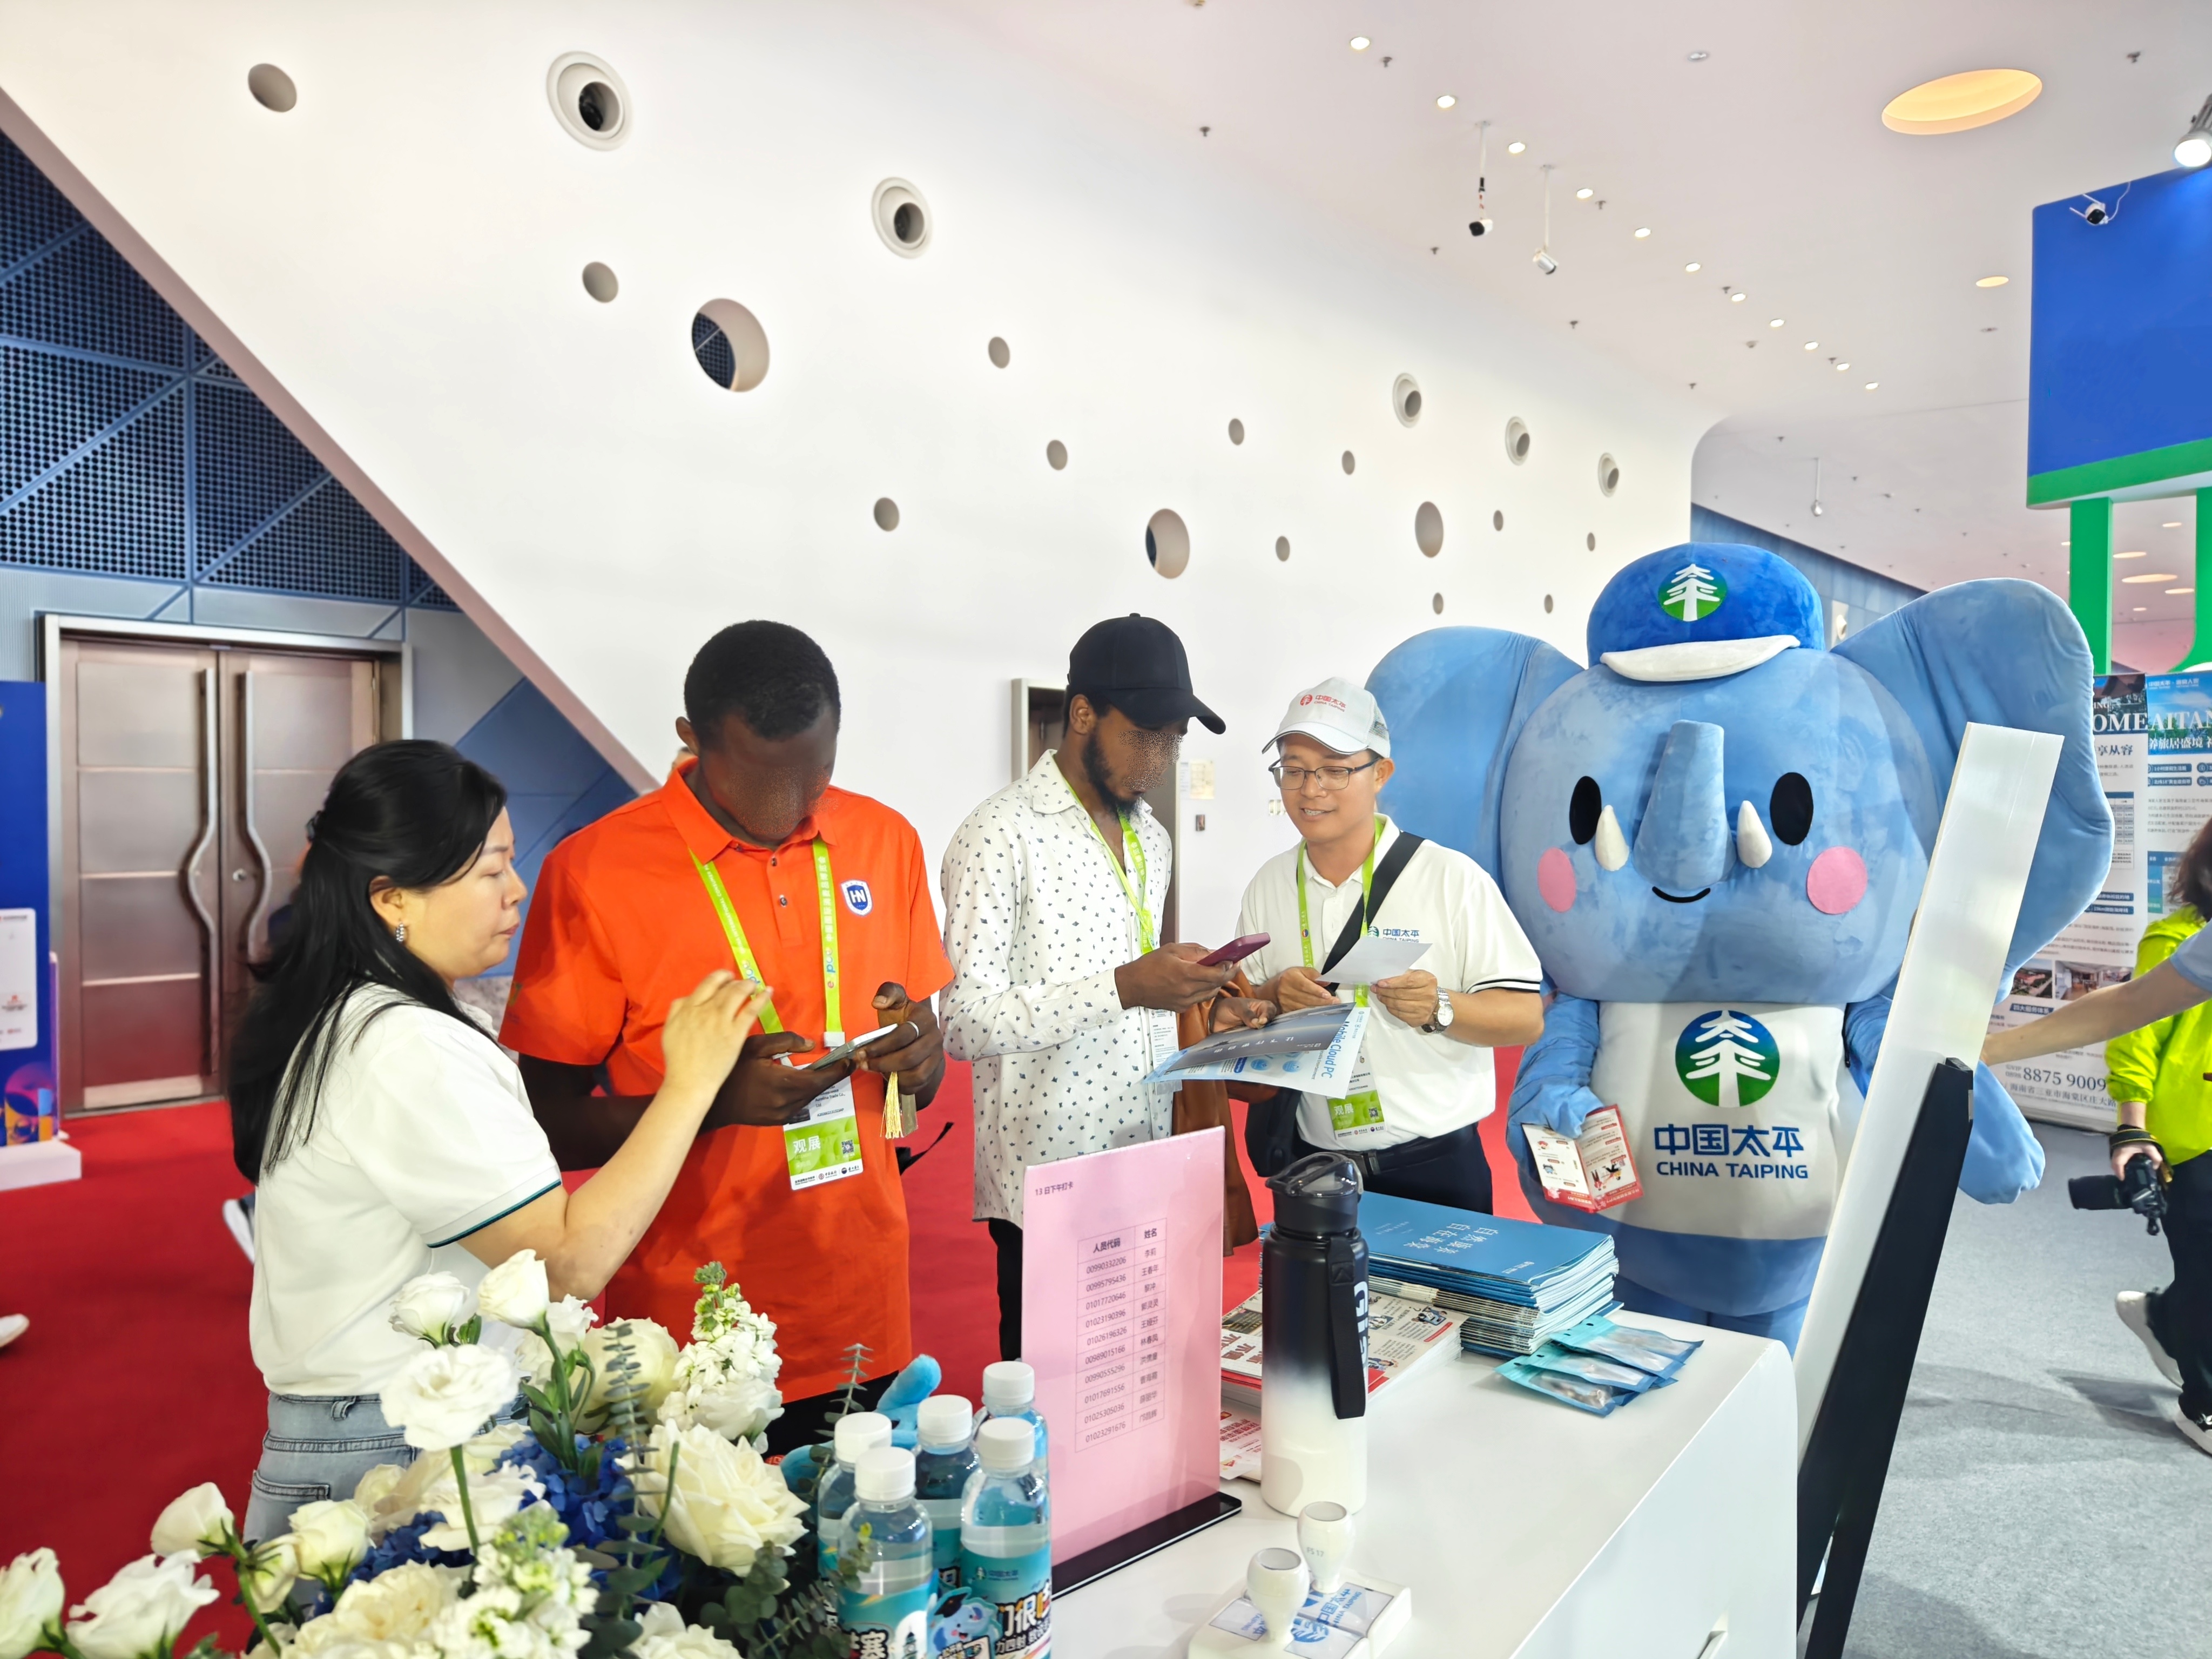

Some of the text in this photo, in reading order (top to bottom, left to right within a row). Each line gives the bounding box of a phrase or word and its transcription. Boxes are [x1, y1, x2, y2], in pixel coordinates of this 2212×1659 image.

[1316, 695, 1346, 708] 中国太平
[2093, 713, 2148, 732] OME
[2148, 710, 2212, 731] AITAN
[818, 856, 833, 942] 中国国际消费品博览会
[849, 889, 866, 903] HN
[1383, 928, 1419, 937] 中国太平
[1326, 1044, 1341, 1070] Cloud
[1321, 1068, 1335, 1078] PC
[2024, 1067, 2107, 1092] 8875 9009
[1334, 1103, 1354, 1116] 观展
[793, 1135, 821, 1154] 观展
[1654, 1123, 1804, 1158] 中国太平
[1656, 1161, 1809, 1179] CHINA TAIPING
[1044, 1182, 1074, 1195] 日下午打卡
[1144, 1228, 1157, 1239] 姓名
[1092, 1238, 1121, 1253] 人员代码
[1086, 1257, 1127, 1274] 00990332206
[1086, 1274, 1127, 1292] 00995795436
[1085, 1291, 1126, 1310] 01017720646
[1085, 1309, 1126, 1328] 01023190396
[1087, 1326, 1127, 1345] 01026196326
[1085, 1345, 1125, 1364] 00989015166
[1085, 1364, 1125, 1384] 00990555296
[1084, 1383, 1125, 1404] 01017691556
[1084, 1402, 1125, 1424] 01025305036
[1085, 1421, 1126, 1442] 01023291676
[1344, 1590, 1361, 1610] TAIPING
